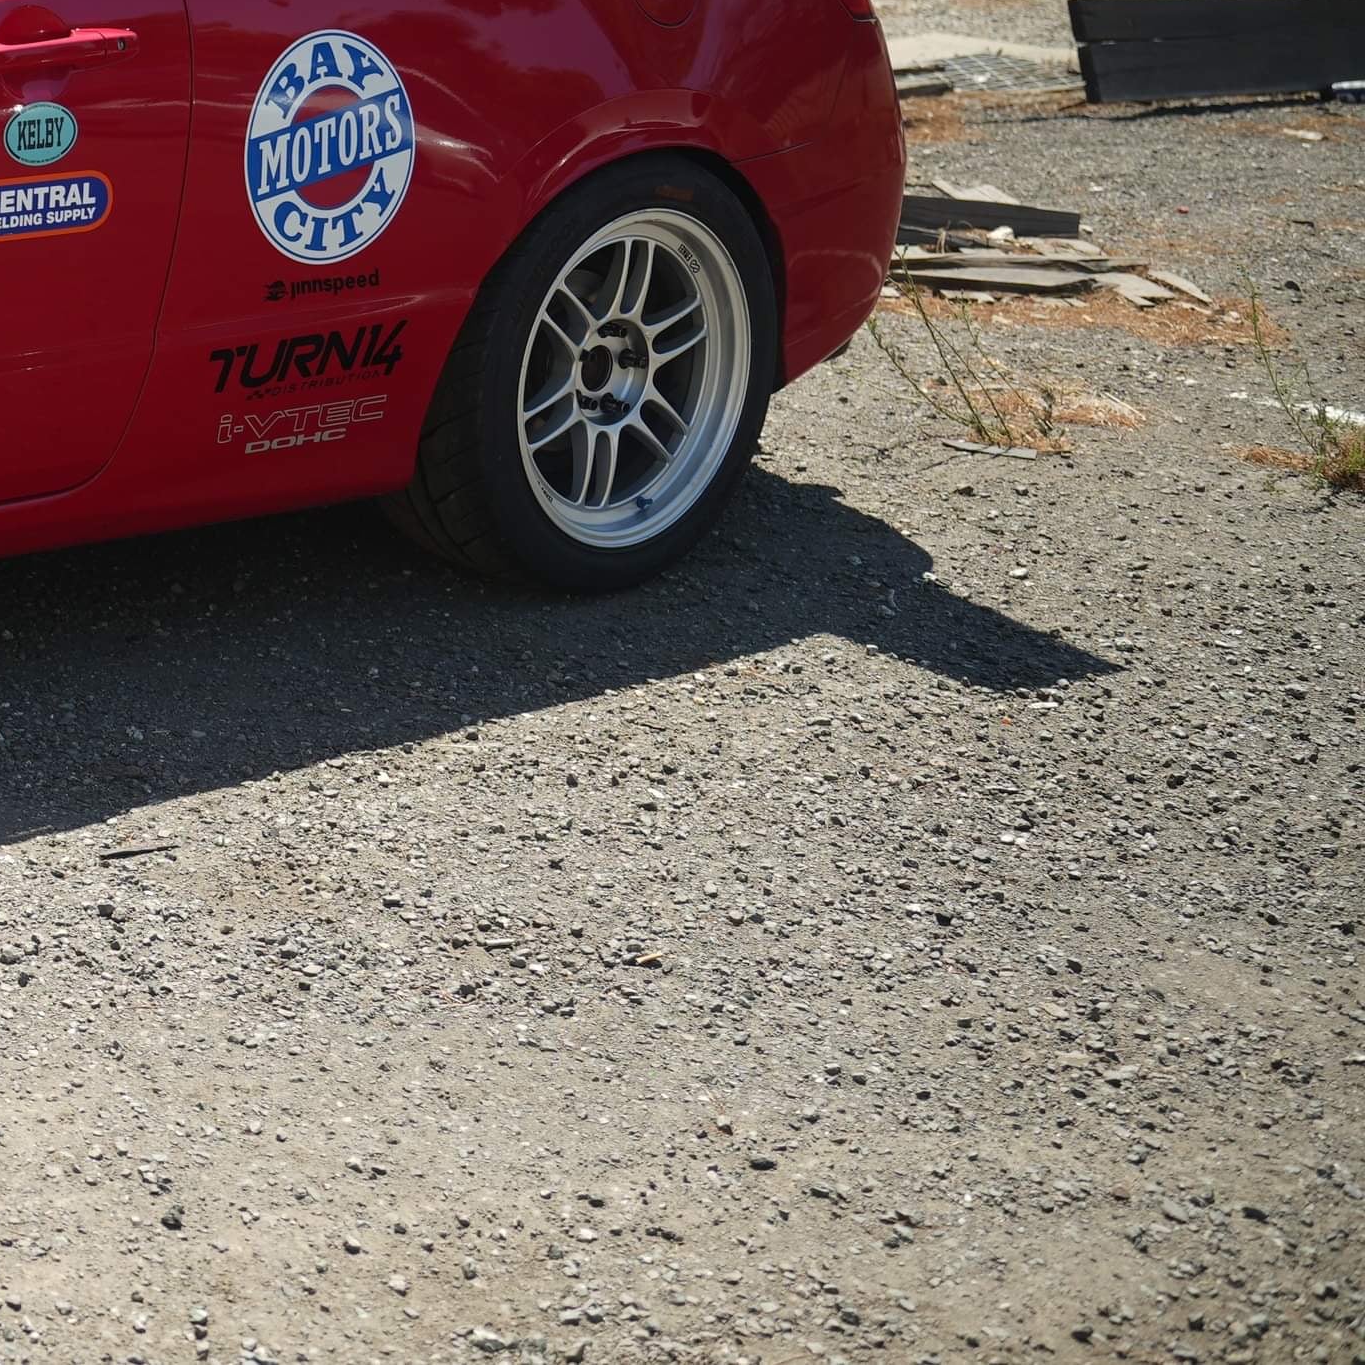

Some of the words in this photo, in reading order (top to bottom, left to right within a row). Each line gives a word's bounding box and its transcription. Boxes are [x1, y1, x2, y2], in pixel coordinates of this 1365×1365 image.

[264, 41, 384, 119] BAY
[17, 117, 64, 151] KELBY
[257, 94, 403, 195] MOTORS
[46, 207, 96, 224] SUPPLY
[274, 167, 396, 251] CITY
[209, 319, 408, 394] TURN14
[272, 369, 381, 397] DISTRIBUTION
[217, 394, 387, 444] i-VTEC
[244, 428, 347, 454] DOHC
